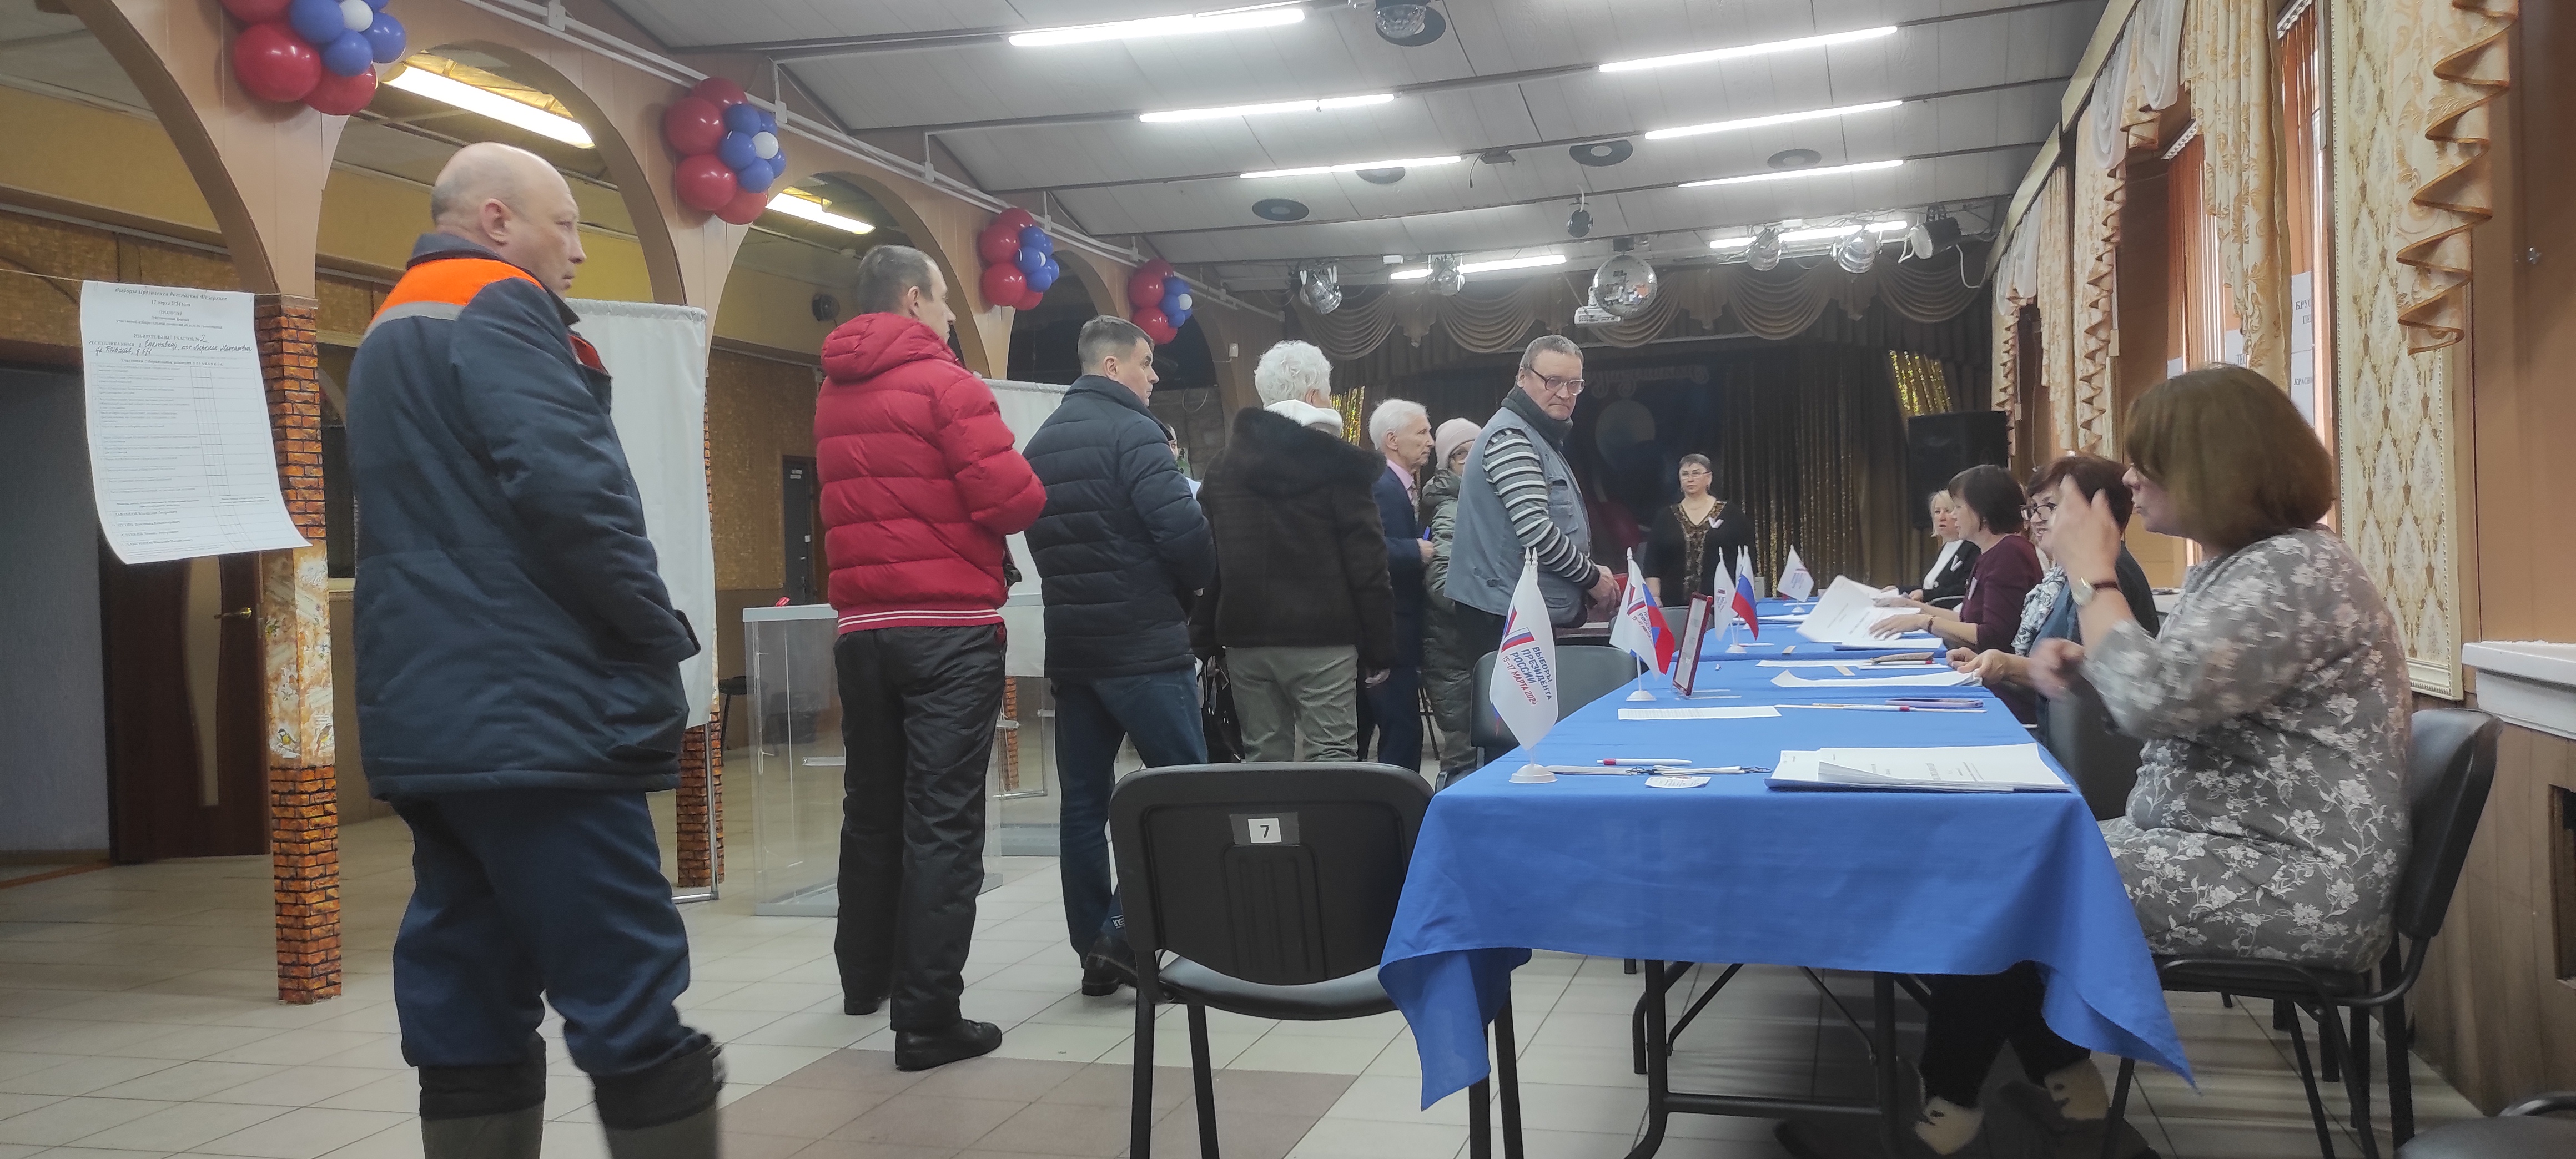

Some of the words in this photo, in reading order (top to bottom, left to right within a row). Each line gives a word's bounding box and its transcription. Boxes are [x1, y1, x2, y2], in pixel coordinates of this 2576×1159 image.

[1510, 652, 1537, 684] РОССИИ
[1521, 648, 1552, 701] ПРЕЗИДЕНТА
[1532, 646, 1553, 683] ВЫБОРЫ
[1511, 671, 1528, 691] МАРТА
[1525, 691, 1538, 706] 2024
[1260, 825, 1270, 838] 7
